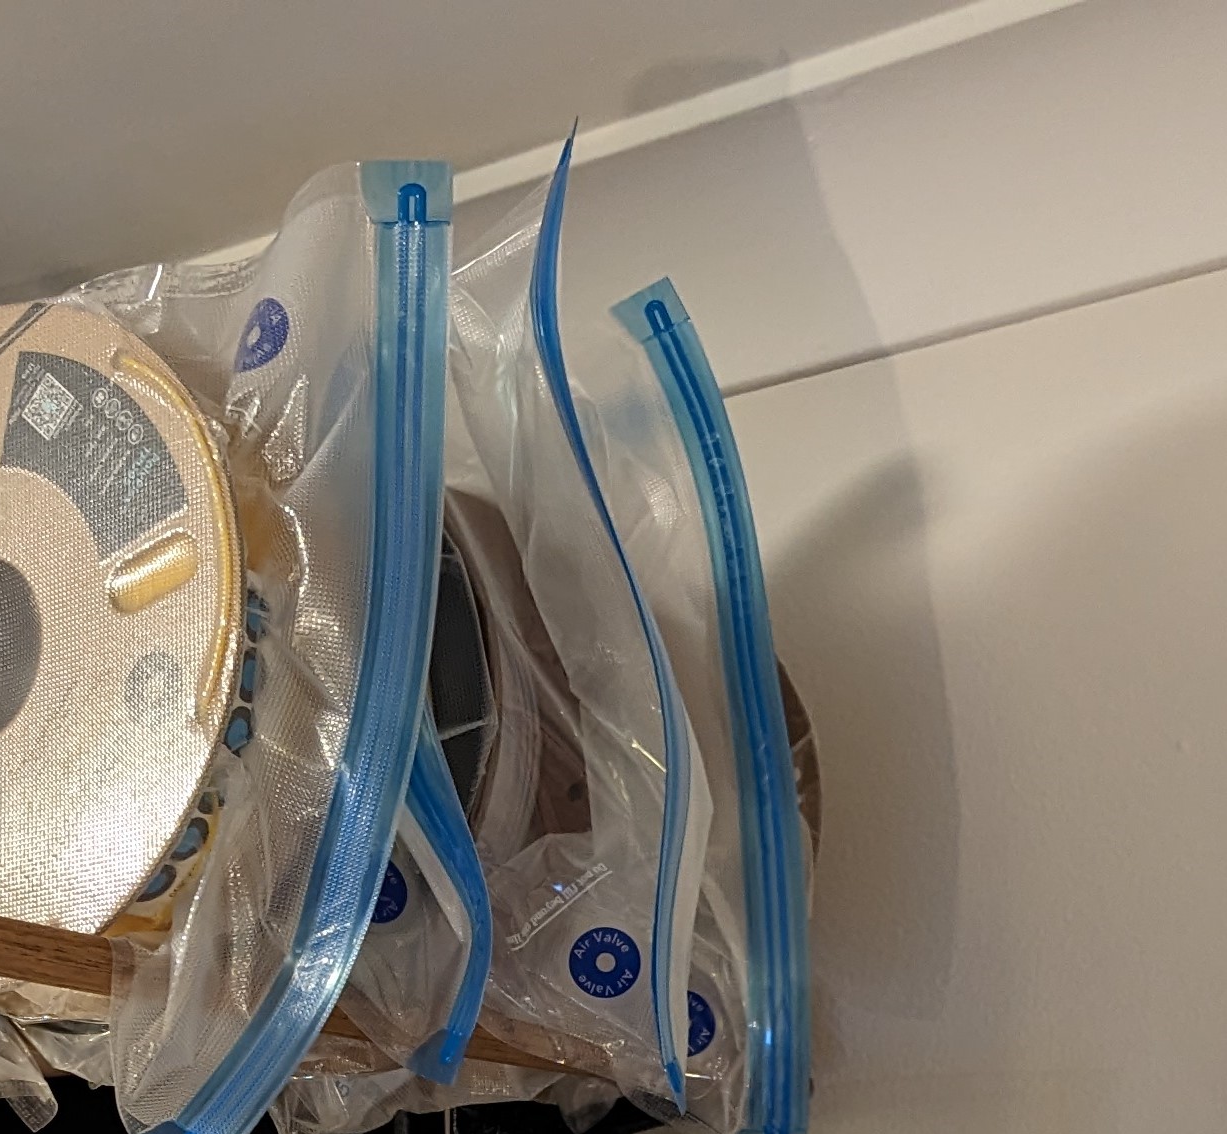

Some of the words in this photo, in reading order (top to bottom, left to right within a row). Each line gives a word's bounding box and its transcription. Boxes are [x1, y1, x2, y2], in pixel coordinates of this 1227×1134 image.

[574, 939, 591, 959] Air
[593, 931, 629, 953] Valve
[578, 975, 614, 996] Valve
[616, 969, 633, 987] Air
